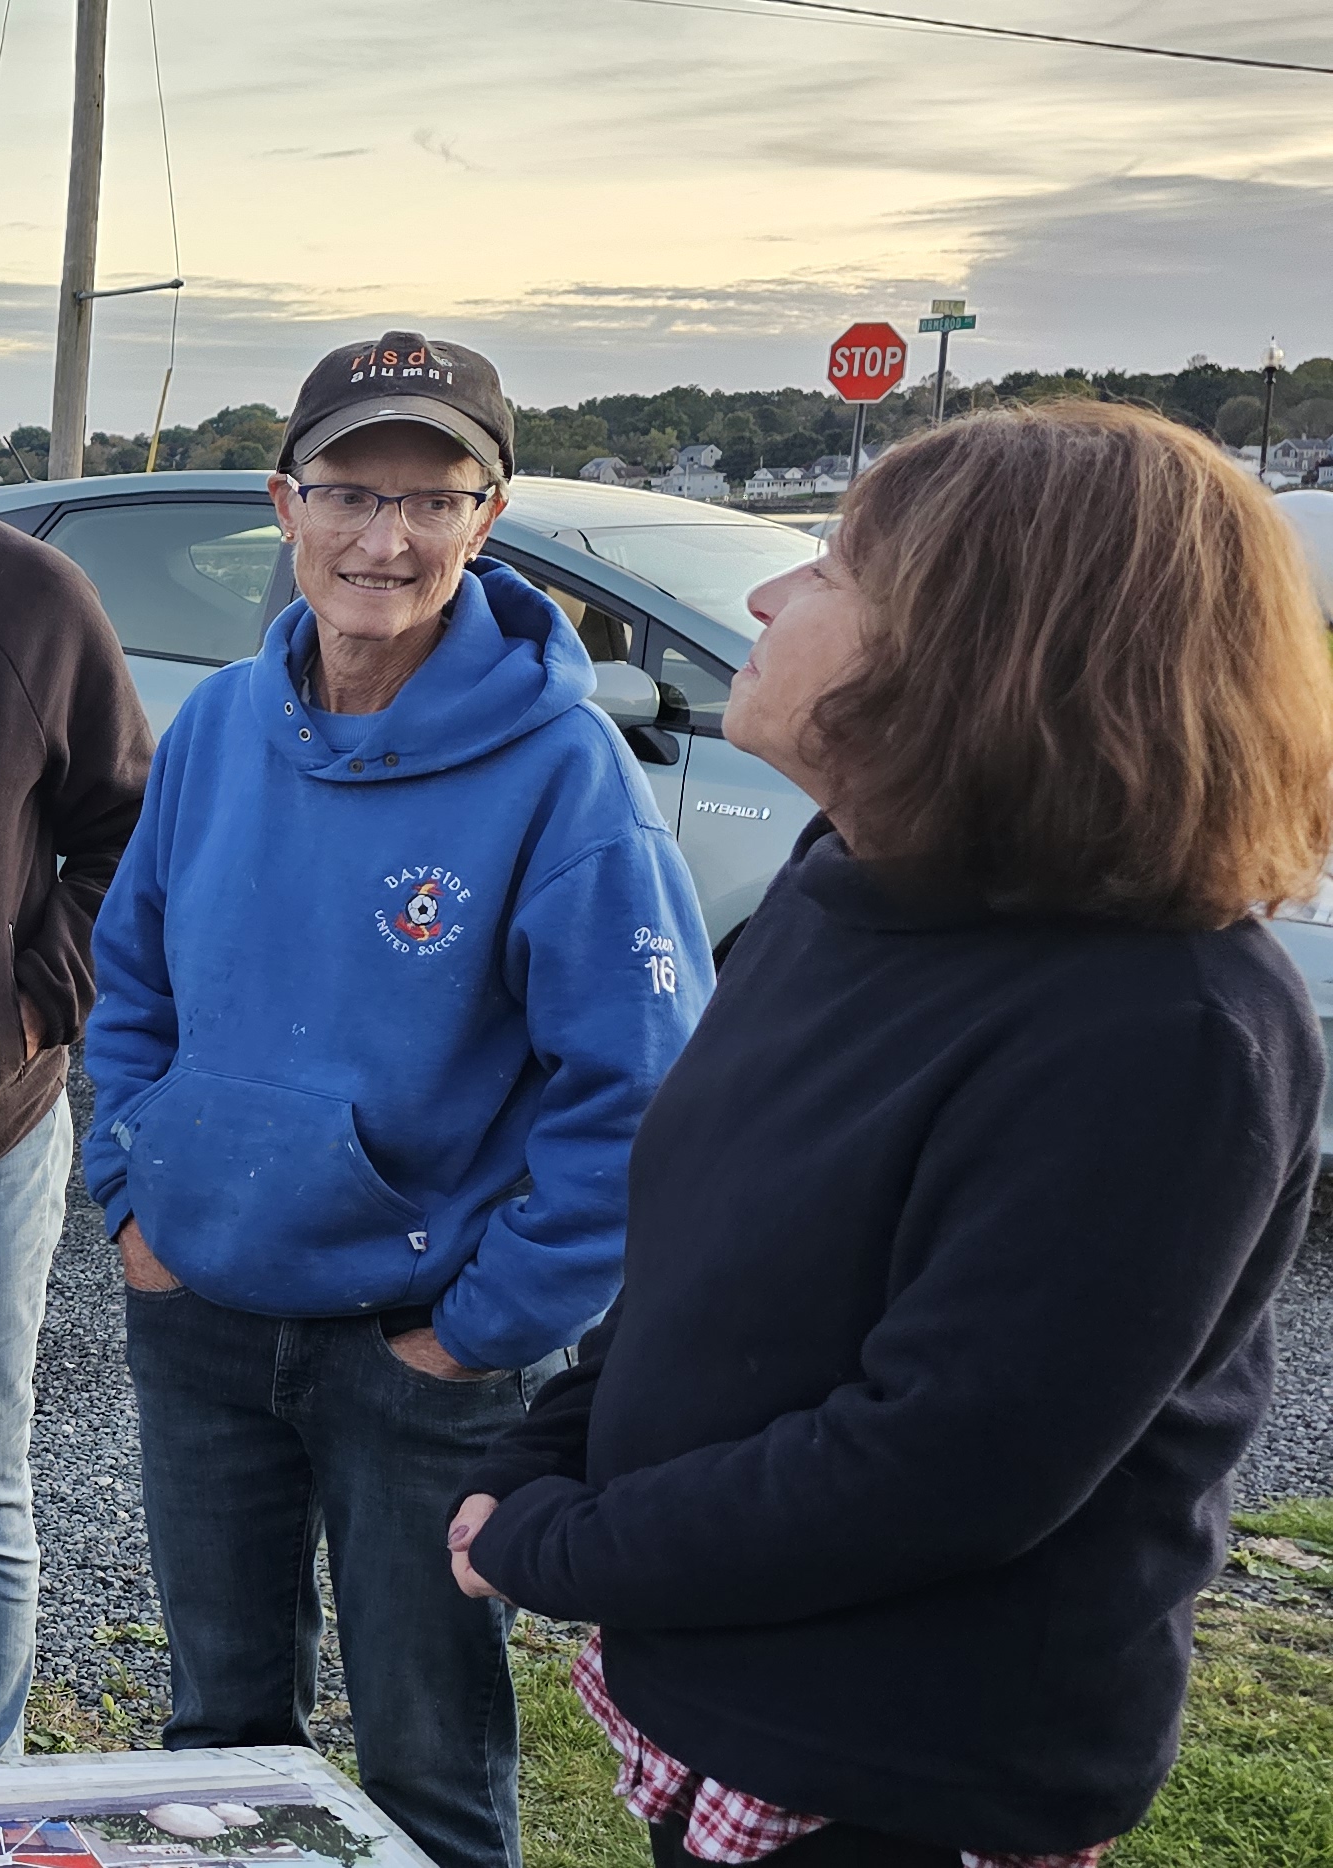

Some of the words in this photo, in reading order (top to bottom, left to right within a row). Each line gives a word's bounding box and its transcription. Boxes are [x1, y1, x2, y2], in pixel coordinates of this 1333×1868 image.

[921, 318, 962, 331] ORMEROD
[351, 347, 425, 370] risd
[832, 346, 902, 378] STOP
[350, 365, 453, 385] alumni
[696, 800, 759, 819] HYBRID
[384, 866, 471, 903] BAYSIDE
[374, 909, 410, 953] UNITED
[417, 924, 464, 955] SOCCER
[644, 956, 675, 994] 16
